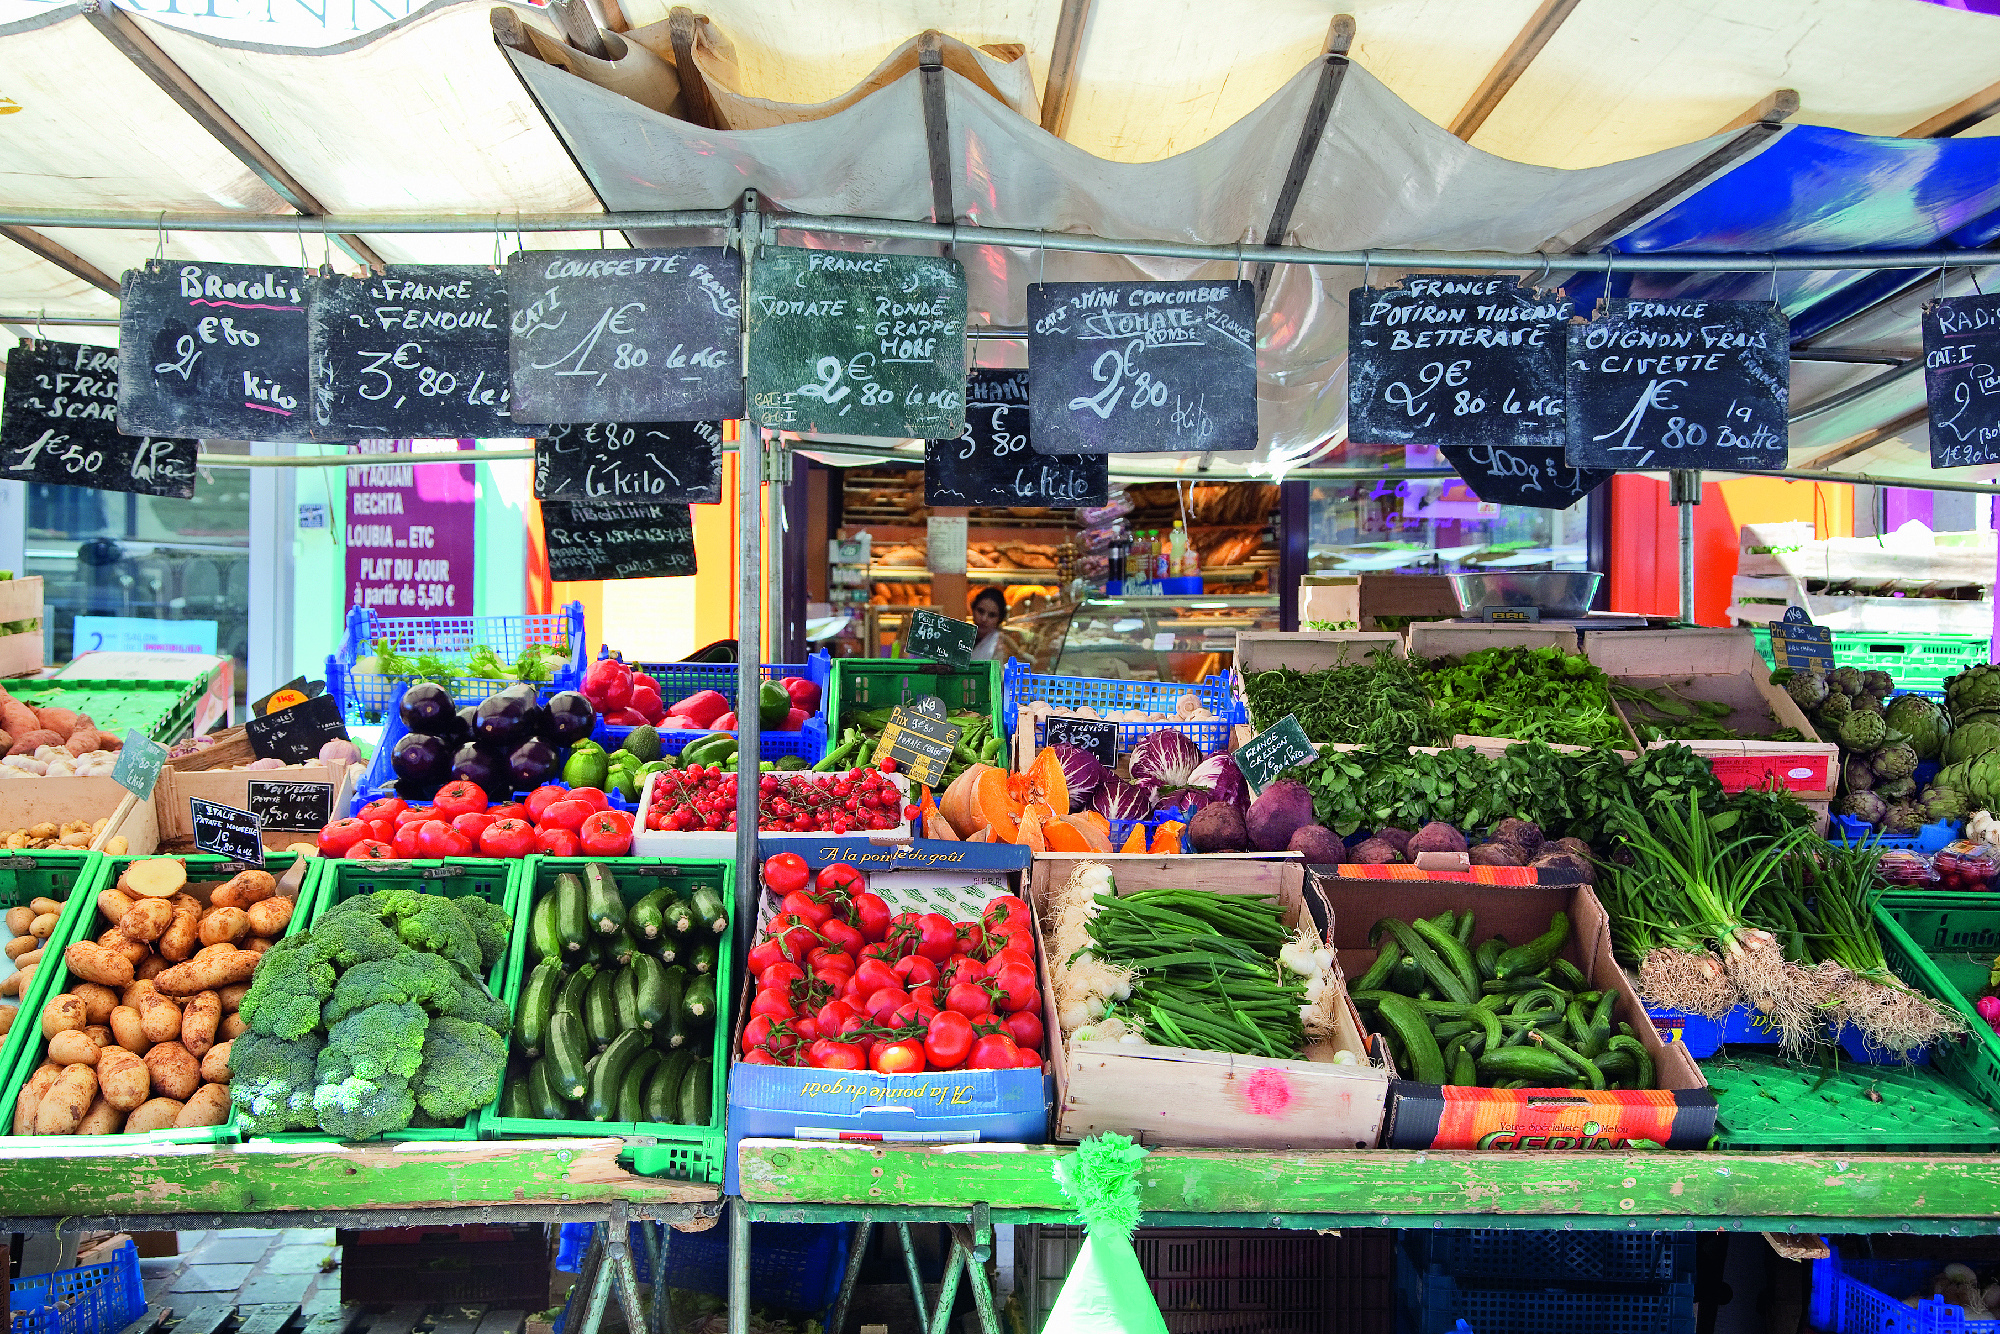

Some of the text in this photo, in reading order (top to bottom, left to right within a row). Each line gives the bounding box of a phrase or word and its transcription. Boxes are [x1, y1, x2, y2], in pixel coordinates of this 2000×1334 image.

[545, 254, 687, 280] COURGETTE
[809, 254, 889, 272] FRANCE
[381, 279, 472, 300] FRANCE
[1411, 280, 1502, 298] FRANCE
[758, 296, 946, 316] TOMATE RONDE
[1477, 302, 1573, 322] MUSCADE
[1628, 302, 1708, 319] FRANCE
[374, 306, 498, 331] FENOUIL
[875, 320, 961, 336] GRAPPE
[1145, 328, 1196, 345] RONDE
[1391, 324, 1549, 351] BETTERAVE
[1600, 353, 1725, 375] CIVETTE
[48, 396, 118, 421] SCAR
[353, 492, 405, 515] RECHTA
[360, 558, 450, 582] PLAT DU JOUR
[353, 582, 456, 610] à partir de 5,50 €
[1771, 622, 1788, 638] Prix
[890, 706, 909, 727] Prix
[1245, 731, 1279, 761] FRANCE
[205, 805, 237, 821] ITALIE
[818, 847, 839, 861] A
[841, 848, 858, 861] la
[908, 849, 926, 861] du
[926, 851, 966, 866] goût
[799, 1077, 975, 1106] A la pointe du goût
